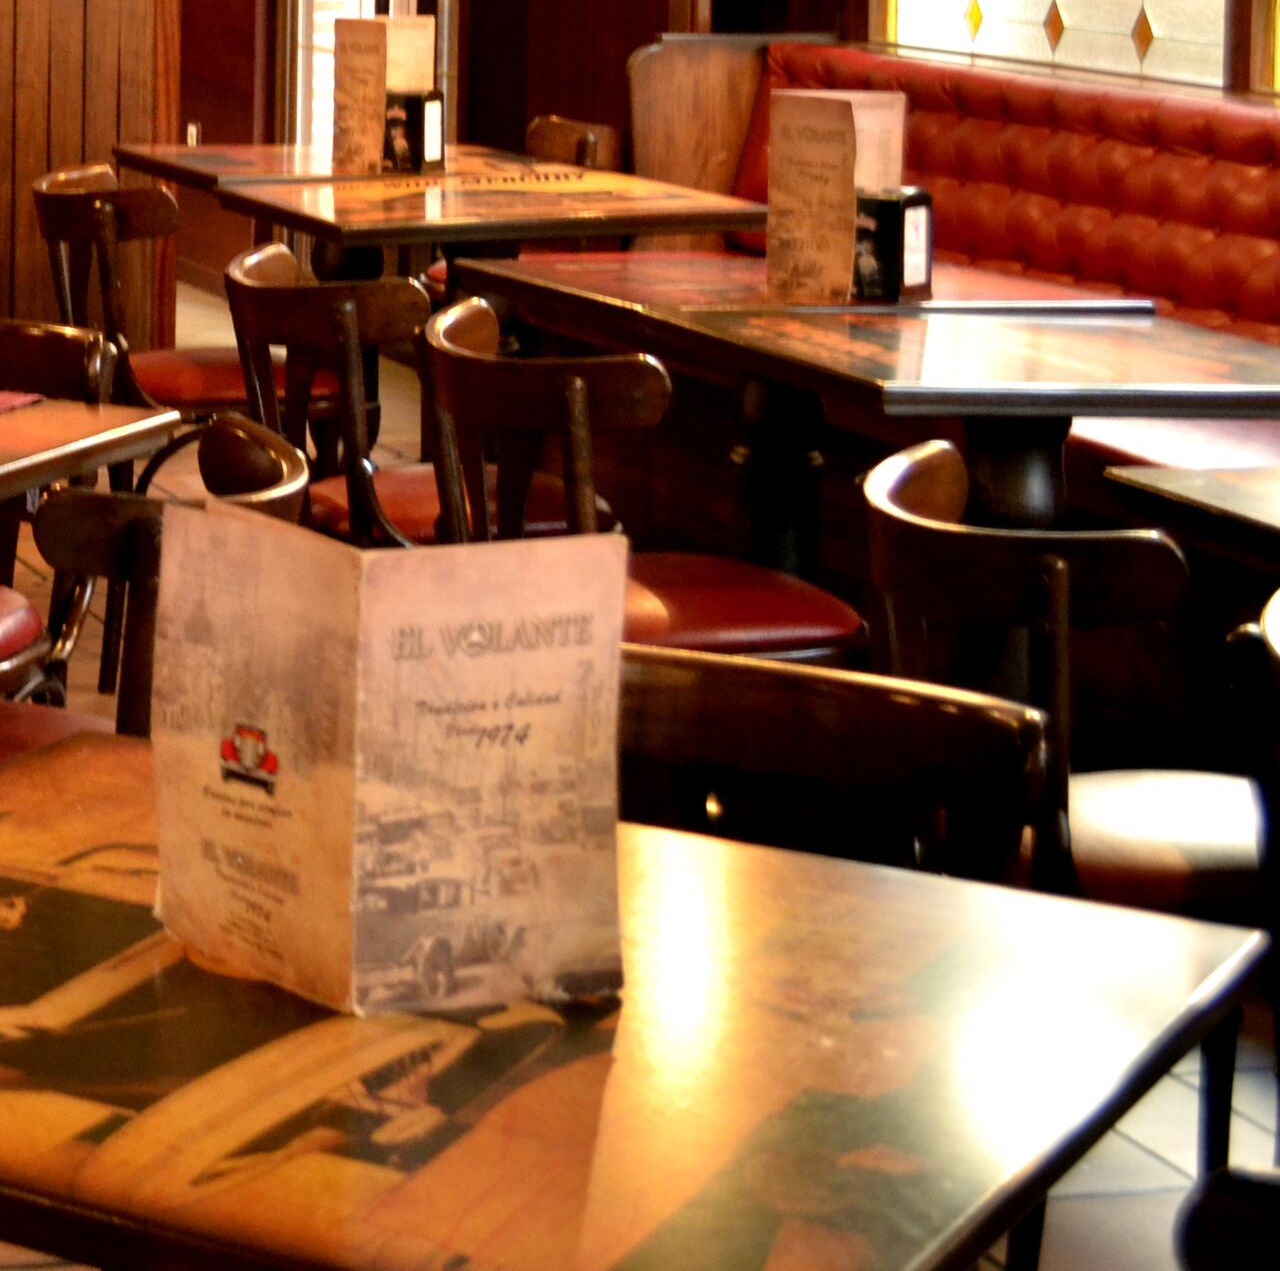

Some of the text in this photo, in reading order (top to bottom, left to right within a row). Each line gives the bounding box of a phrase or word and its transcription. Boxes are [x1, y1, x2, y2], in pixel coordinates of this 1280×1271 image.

[390, 610, 594, 662] EL VOLANTE
[475, 719, 534, 752] 1974
